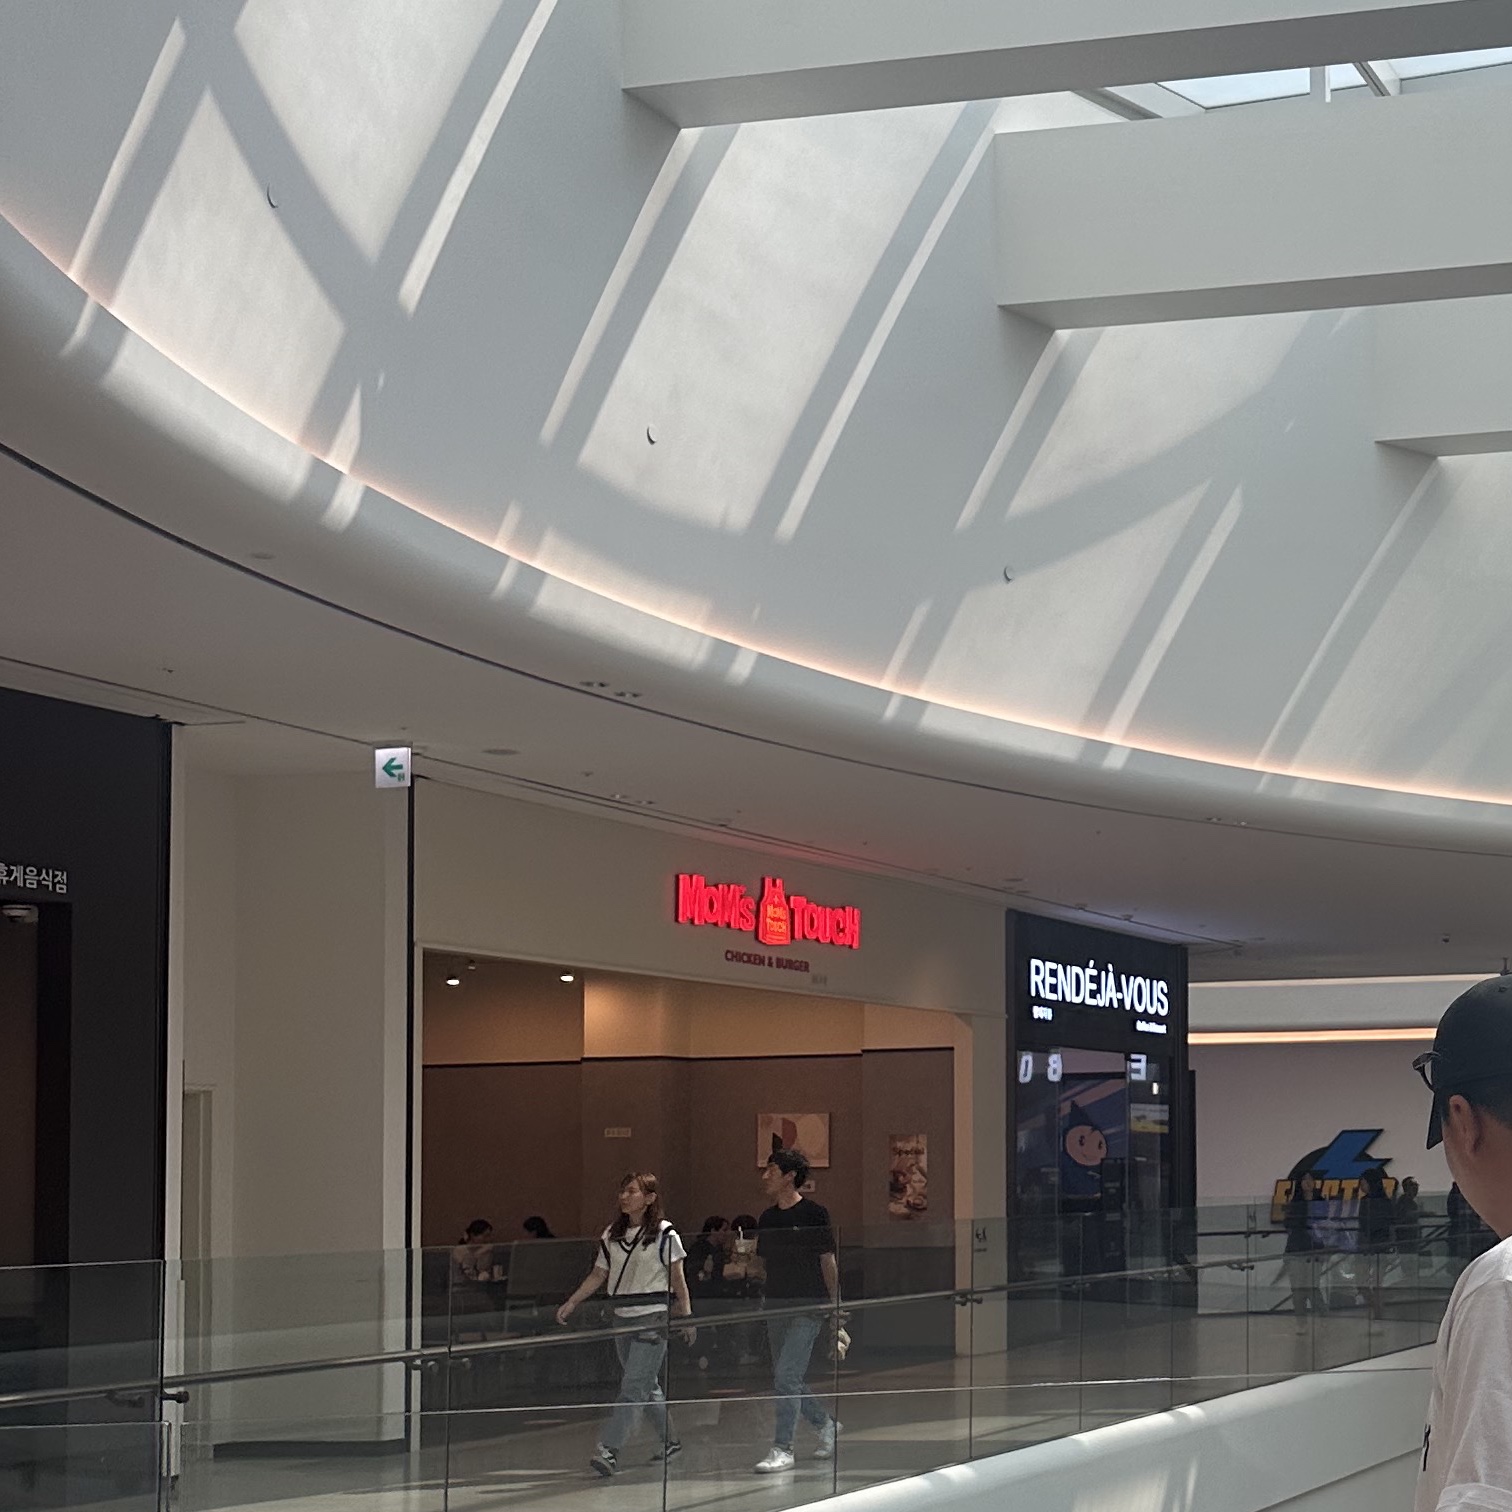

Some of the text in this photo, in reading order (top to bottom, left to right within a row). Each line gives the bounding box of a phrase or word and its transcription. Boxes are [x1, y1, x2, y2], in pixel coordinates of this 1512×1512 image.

[724, 949, 810, 973] CHICKEN & BURGER
[1029, 957, 1170, 1017] RENDÉJÀ-VOUS
